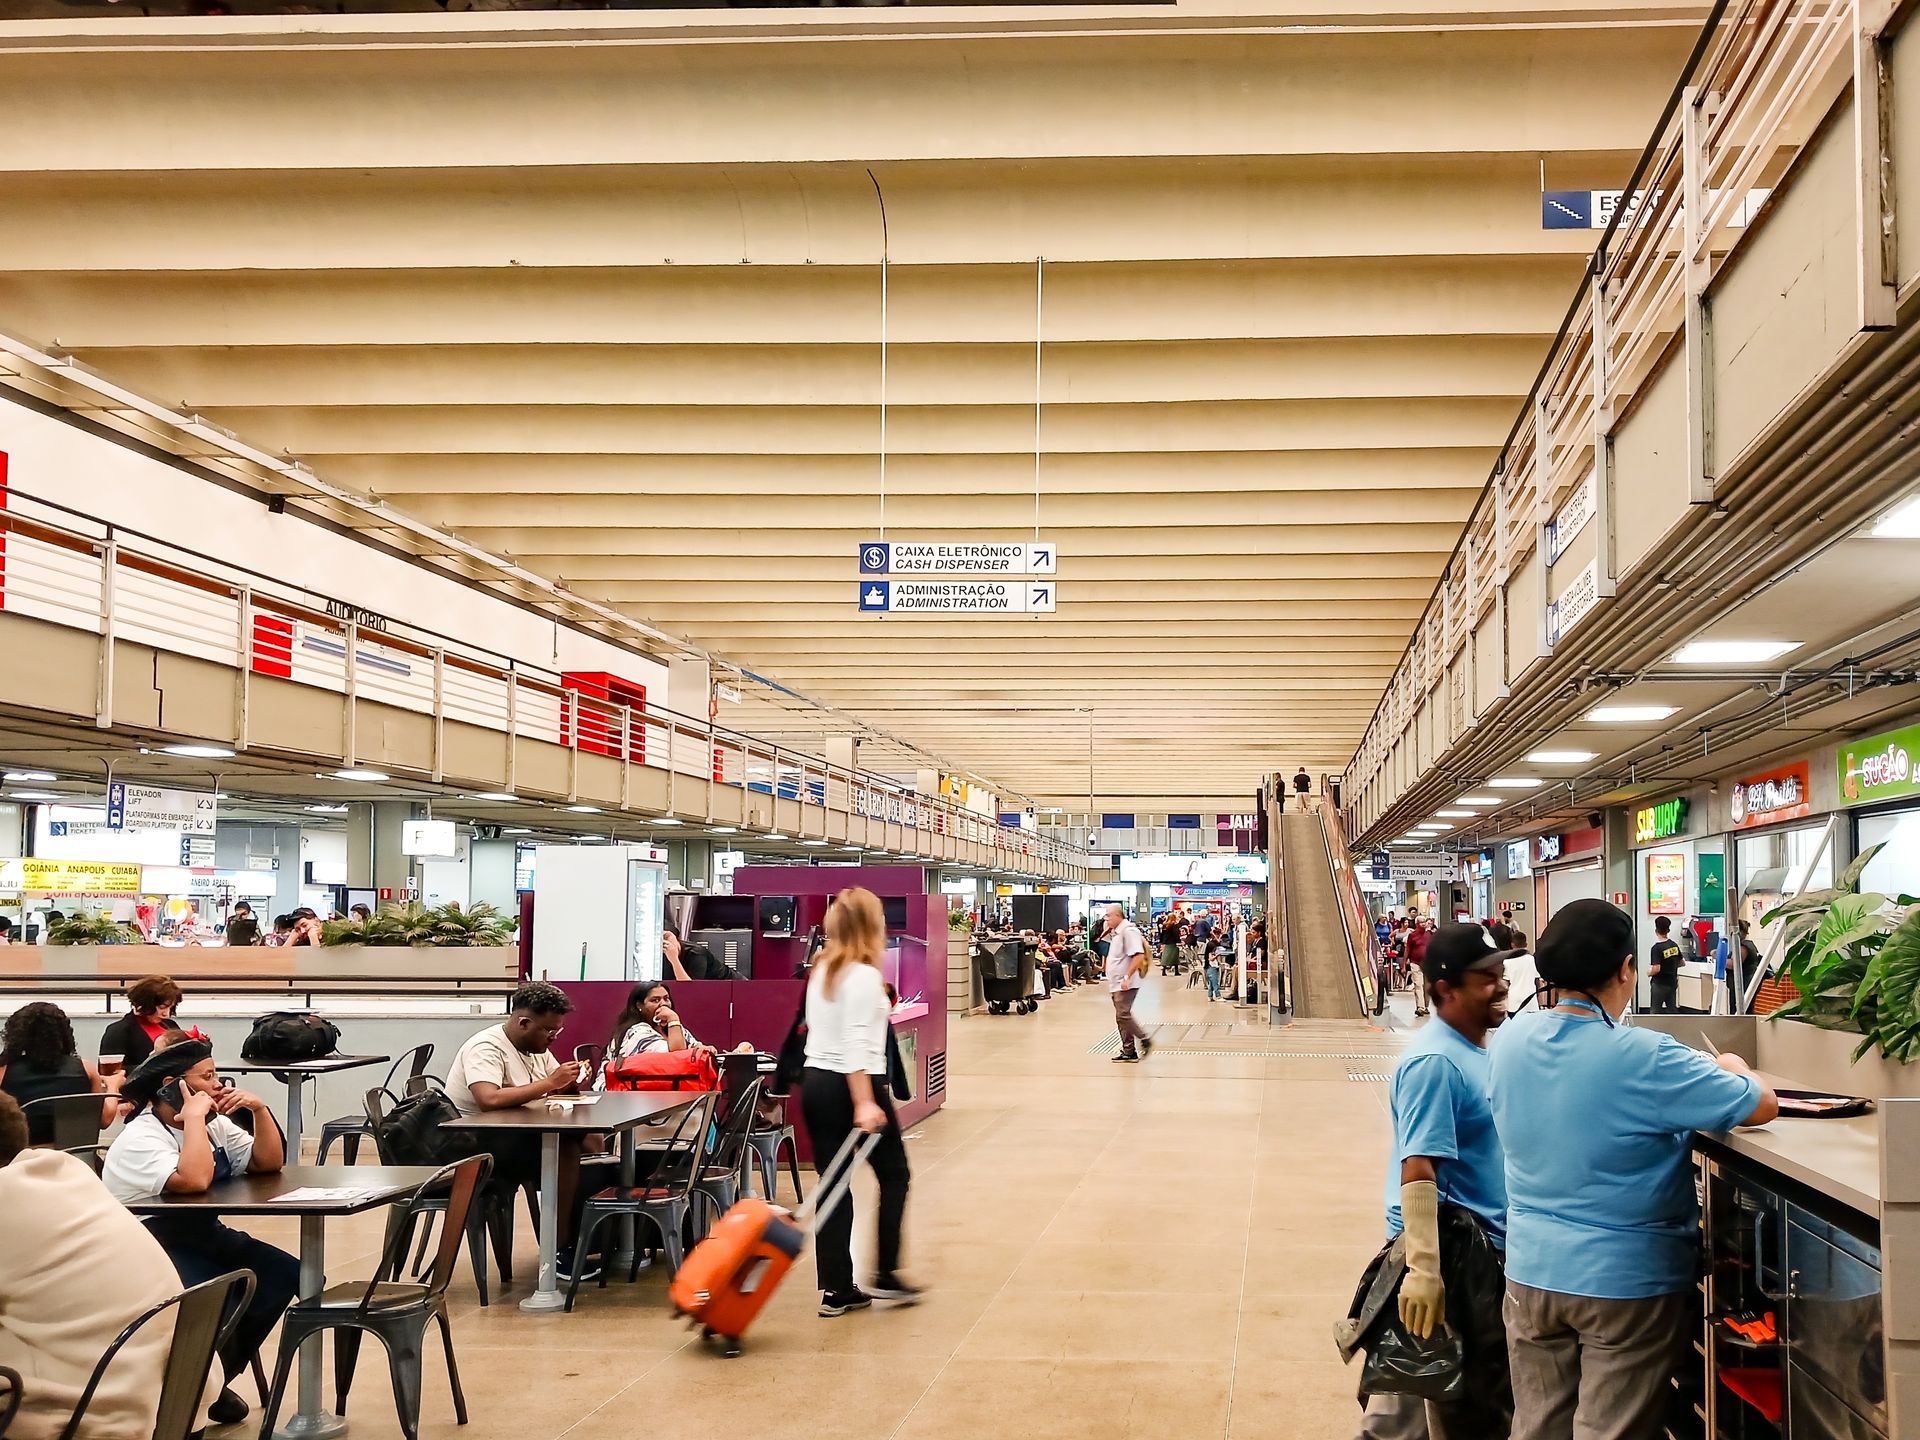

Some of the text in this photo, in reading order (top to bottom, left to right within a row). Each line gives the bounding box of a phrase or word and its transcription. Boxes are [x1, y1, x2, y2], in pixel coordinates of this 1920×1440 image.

[895, 544, 1022, 557] CAIXA ELETRÔNICO
[895, 559, 1009, 570] CASH DISPENSER
[896, 583, 1005, 597] ADMINISTRAÇÃO
[895, 597, 1009, 608] ADMINISTRATION
[128, 788, 162, 799] ELEVADOR
[127, 797, 143, 805] LIFT
[1636, 798, 1681, 844] SUBWAY
[721, 858, 728, 868] E
[1392, 868, 1433, 876] FRALDÁRIO
